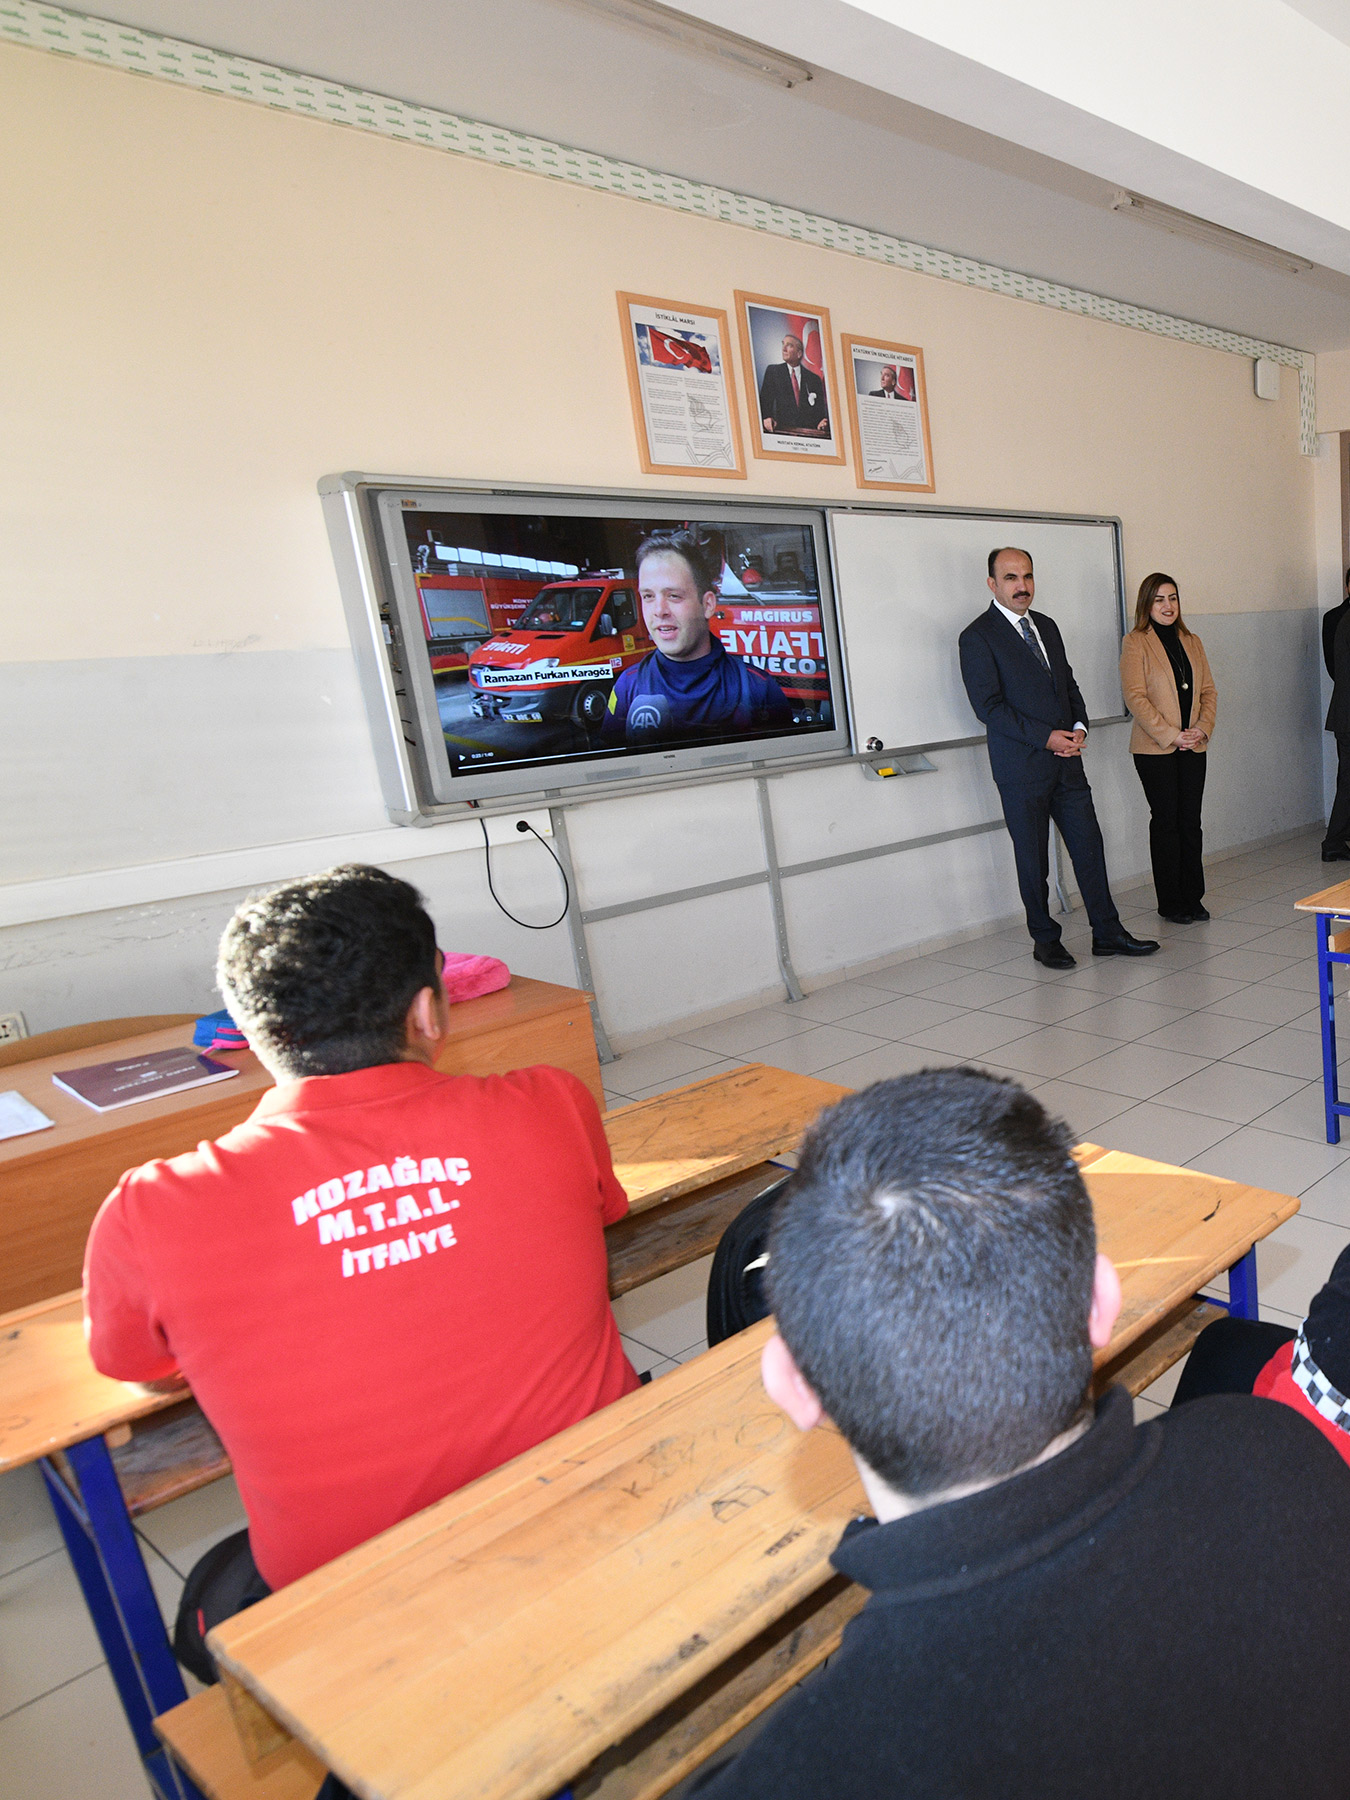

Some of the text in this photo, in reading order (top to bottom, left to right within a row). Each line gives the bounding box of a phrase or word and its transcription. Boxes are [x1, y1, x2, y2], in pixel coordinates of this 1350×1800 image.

[740, 610, 813, 623] MAGIRUS
[484, 667, 611, 684] Ramazan Furkan Karagöz
[291, 1155, 472, 1226] KOZAĞAÇ
[318, 1187, 461, 1245] M.T.A.L.
[342, 1223, 458, 1278] İTFAİYE
